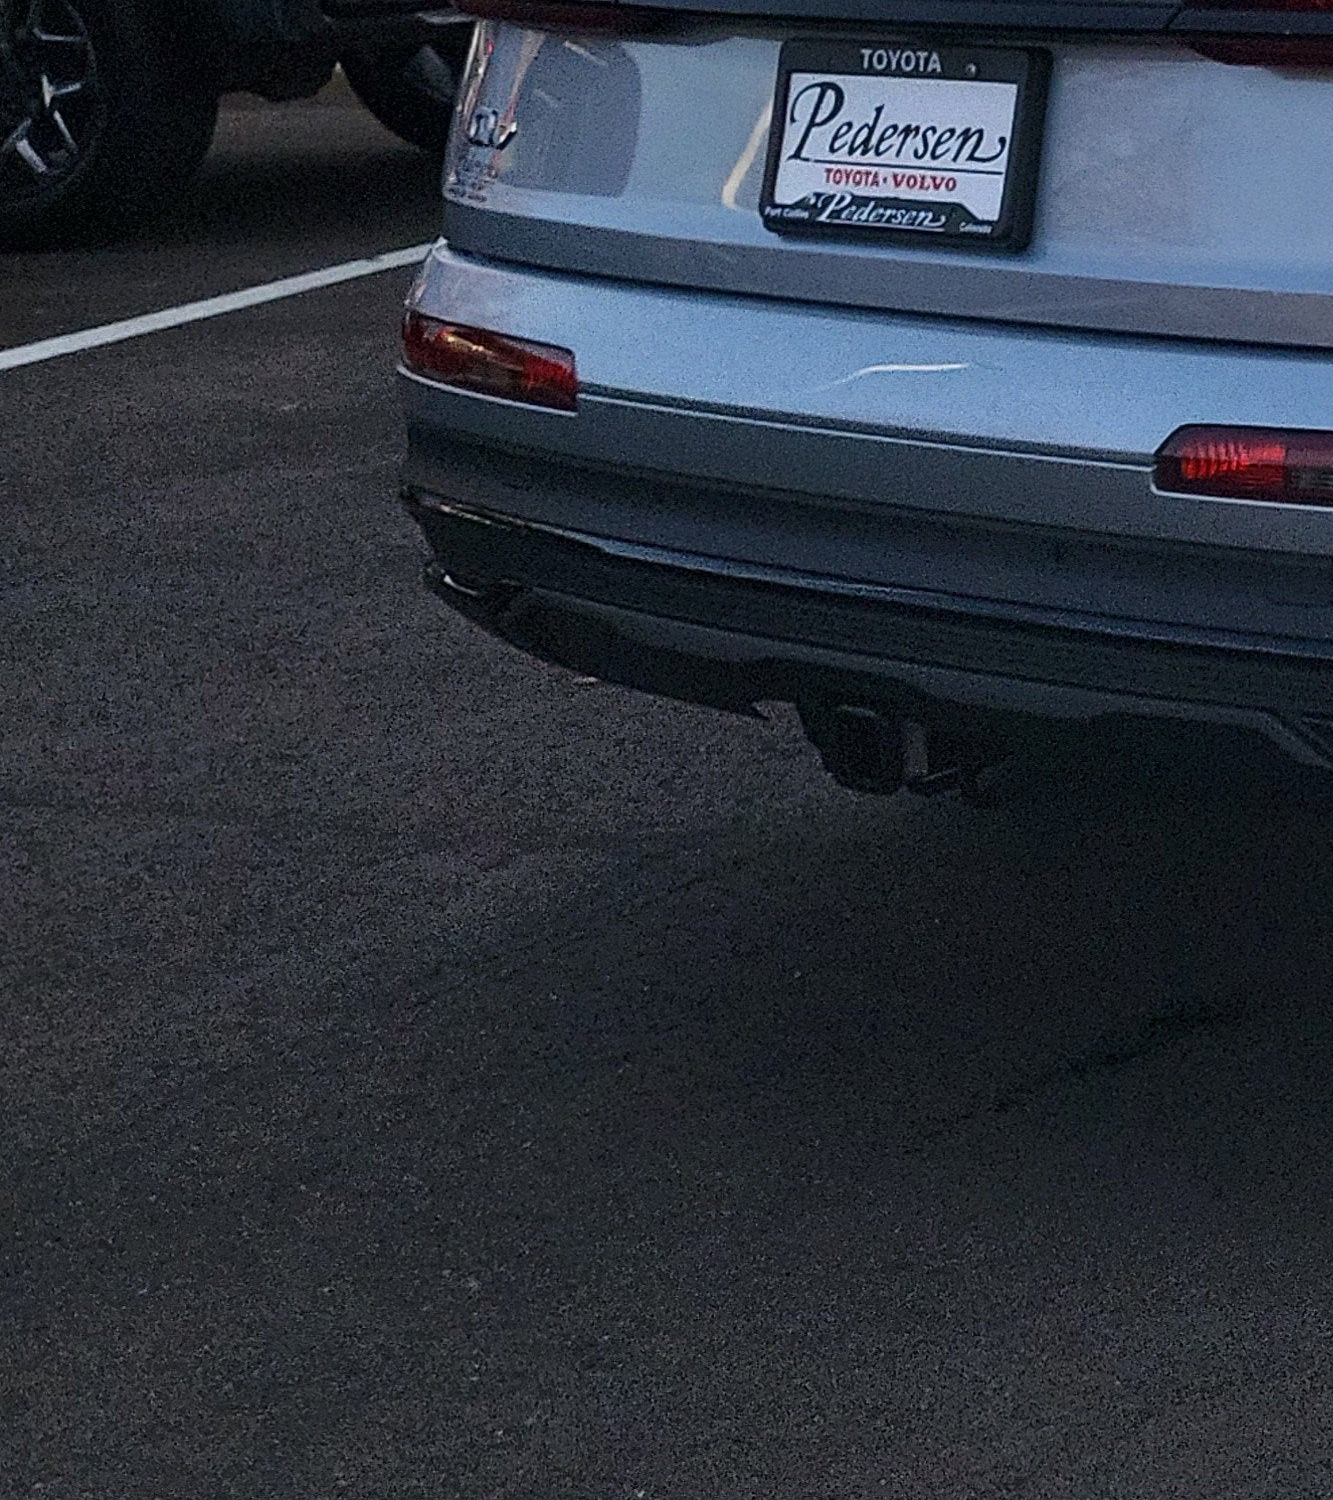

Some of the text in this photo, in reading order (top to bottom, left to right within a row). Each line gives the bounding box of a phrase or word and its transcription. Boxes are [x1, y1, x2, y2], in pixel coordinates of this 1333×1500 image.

[860, 49, 942, 73] TOYOTA
[786, 81, 1006, 164] Pedersen
[824, 167, 957, 192] TOYOTA VOLVO
[806, 192, 946, 228] Pedersen
